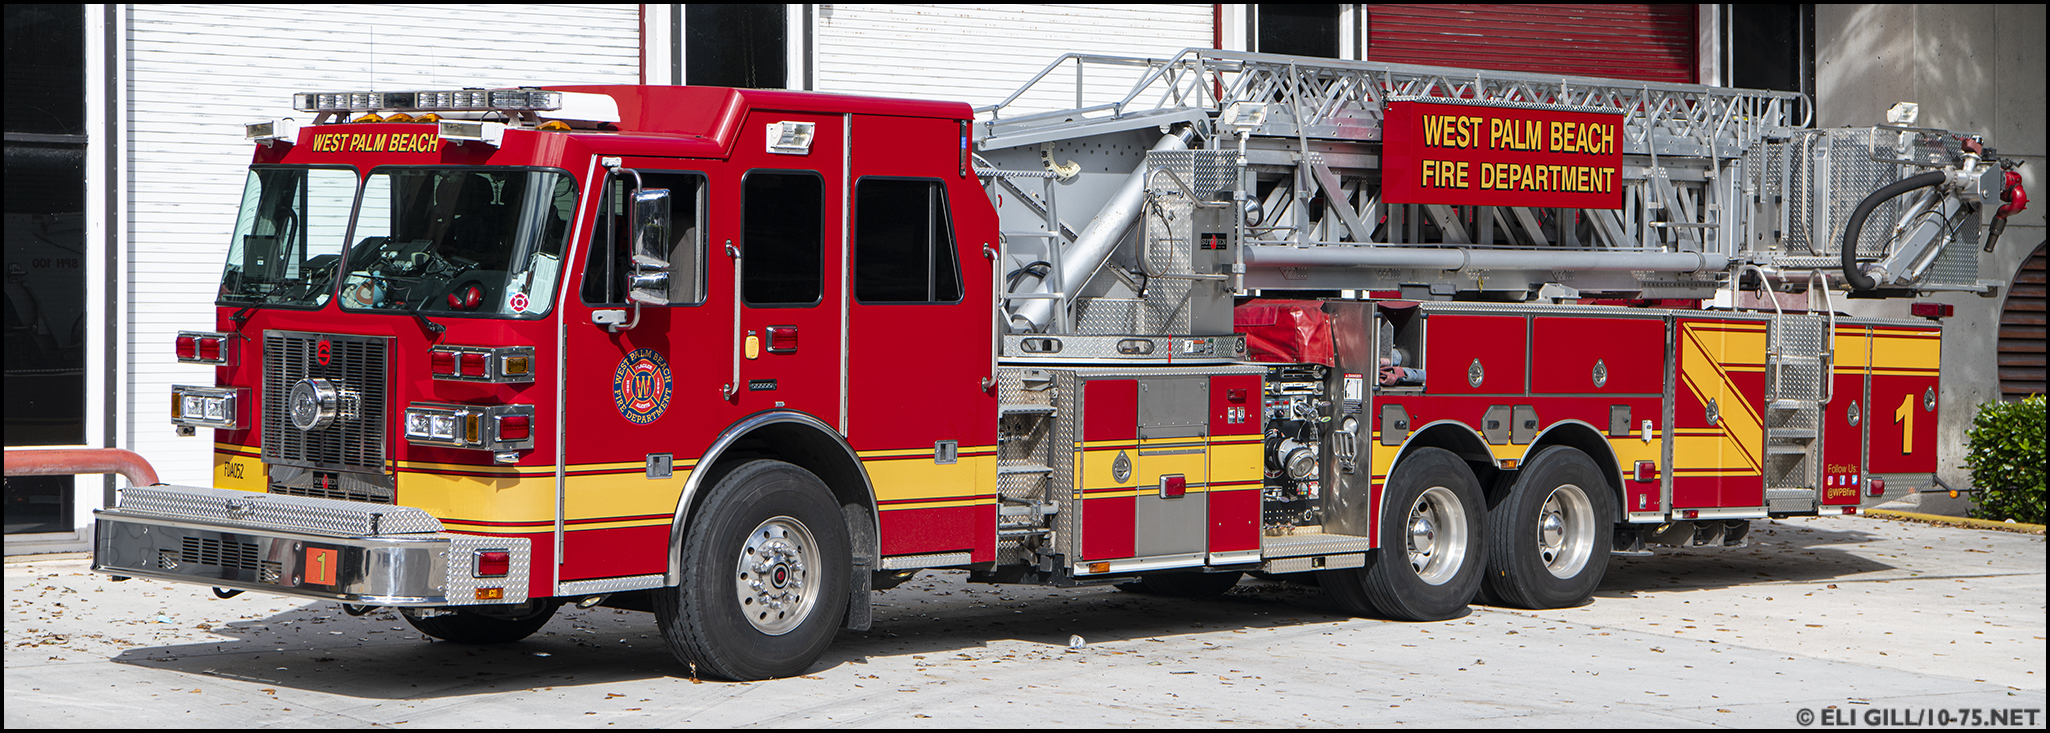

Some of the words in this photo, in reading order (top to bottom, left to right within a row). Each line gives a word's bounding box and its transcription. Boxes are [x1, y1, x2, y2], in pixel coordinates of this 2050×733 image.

[312, 132, 349, 153] WEST
[349, 133, 387, 153] PALM
[388, 132, 439, 153] BEACH
[1422, 114, 1483, 149] WEST
[1489, 117, 1542, 151] PALM
[1549, 121, 1614, 155] BEACH
[1421, 159, 1469, 188] FIRE
[1480, 162, 1615, 193] DEPARTMENT
[615, 358, 630, 384] WEST
[630, 349, 652, 361] PALM
[653, 353, 671, 383] BEACH
[615, 389, 627, 412] FIRE
[626, 388, 671, 423] DEPARTMENT
[1894, 393, 1914, 455] 1
[1827, 464, 1847, 473] Follow
[1848, 464, 1858, 473] Us:
[1827, 487, 1856, 499] @WPBfire
[317, 551, 326, 582] 1
